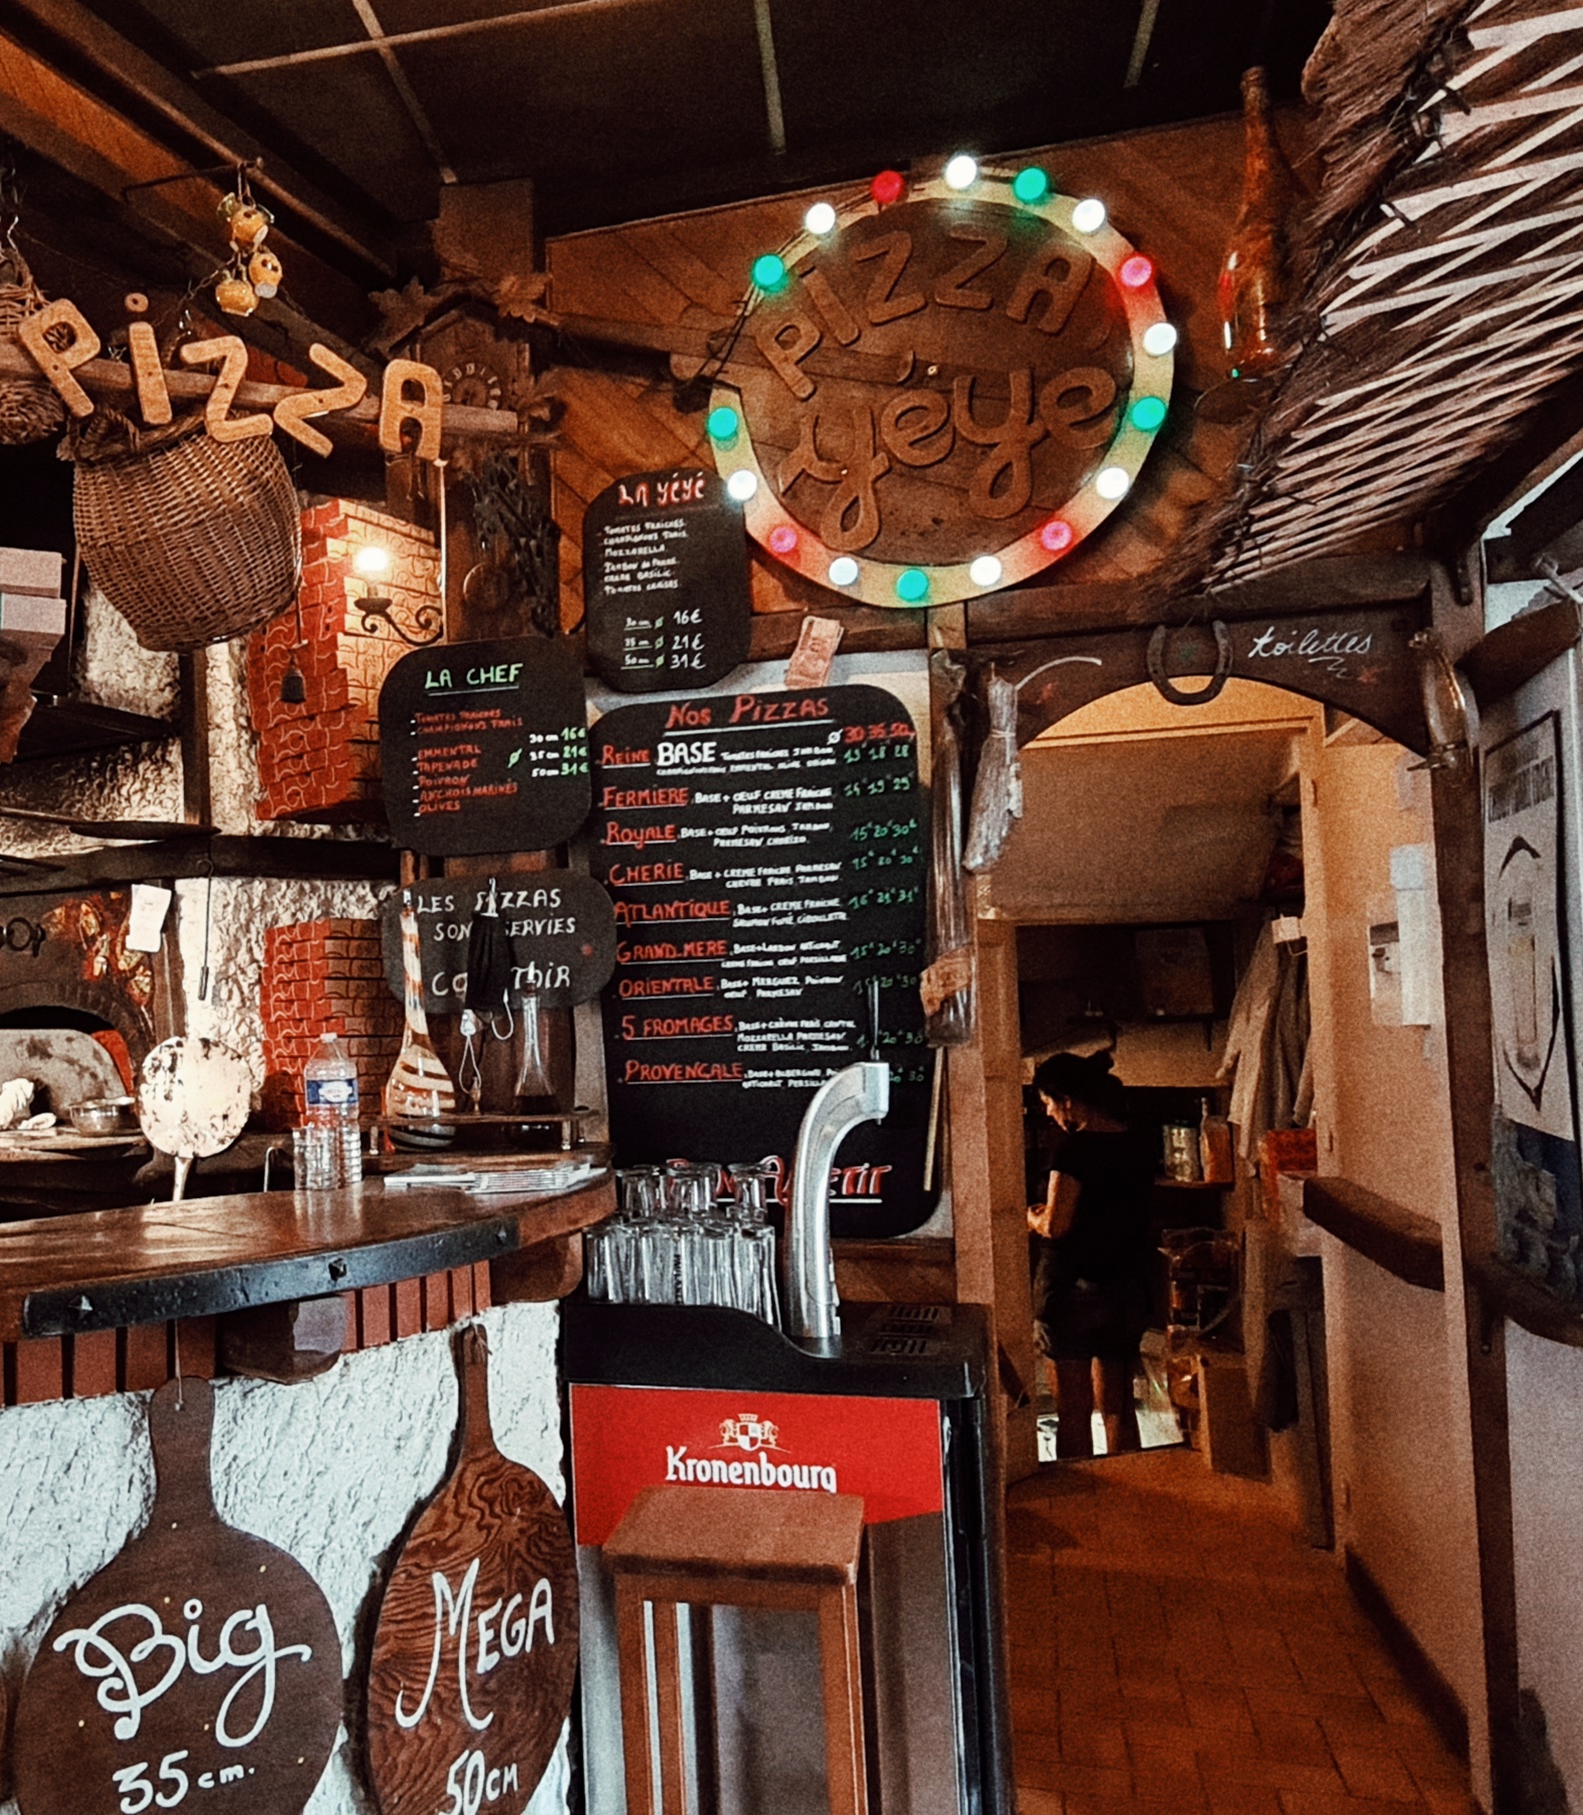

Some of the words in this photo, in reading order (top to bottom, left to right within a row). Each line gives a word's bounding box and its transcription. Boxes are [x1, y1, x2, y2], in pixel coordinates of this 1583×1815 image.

[753, 223, 1096, 400] PIZZA
[425, 669, 452, 689] LA
[467, 663, 523, 685] CHEF
[657, 741, 717, 766] BASE
[418, 800, 461, 813] OLIVES
[607, 821, 676, 849] ROYALE
[609, 862, 684, 885] CHERIE
[417, 895, 455, 913] LES
[619, 976, 714, 998] ORIENTALE
[622, 1015, 636, 1040] 5
[643, 1015, 734, 1038] FROMAGES
[666, 1446, 837, 1493] Kronenbourg
[53, 1599, 312, 1748] Big
[113, 1751, 188, 1814] 35
